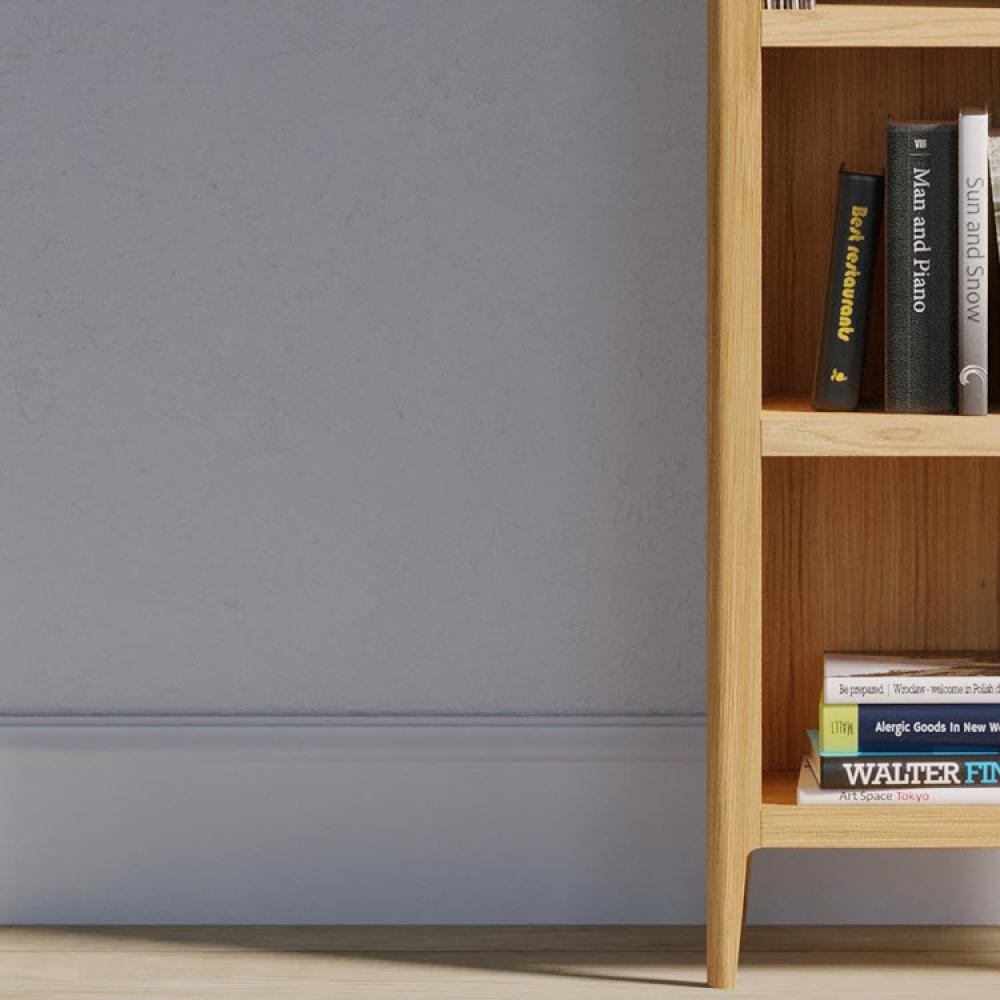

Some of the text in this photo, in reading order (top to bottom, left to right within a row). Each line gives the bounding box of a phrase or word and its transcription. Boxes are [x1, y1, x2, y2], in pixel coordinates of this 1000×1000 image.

[912, 167, 932, 313] Man and Piano
[966, 177, 985, 323] Sun and Snow
[837, 205, 869, 342] Best restaurants
[839, 683, 849, 695] Be
[850, 683, 884, 697] prepared
[929, 683, 964, 695] welcome
[965, 683, 973, 695] in
[973, 683, 994, 695] Polish
[875, 720, 911, 737] Alergic
[913, 720, 947, 733] Goods
[950, 720, 961, 733] In
[963, 720, 986, 733] New
[843, 763, 961, 785] WALTER
[839, 790, 930, 803] Art Space Tokyo
